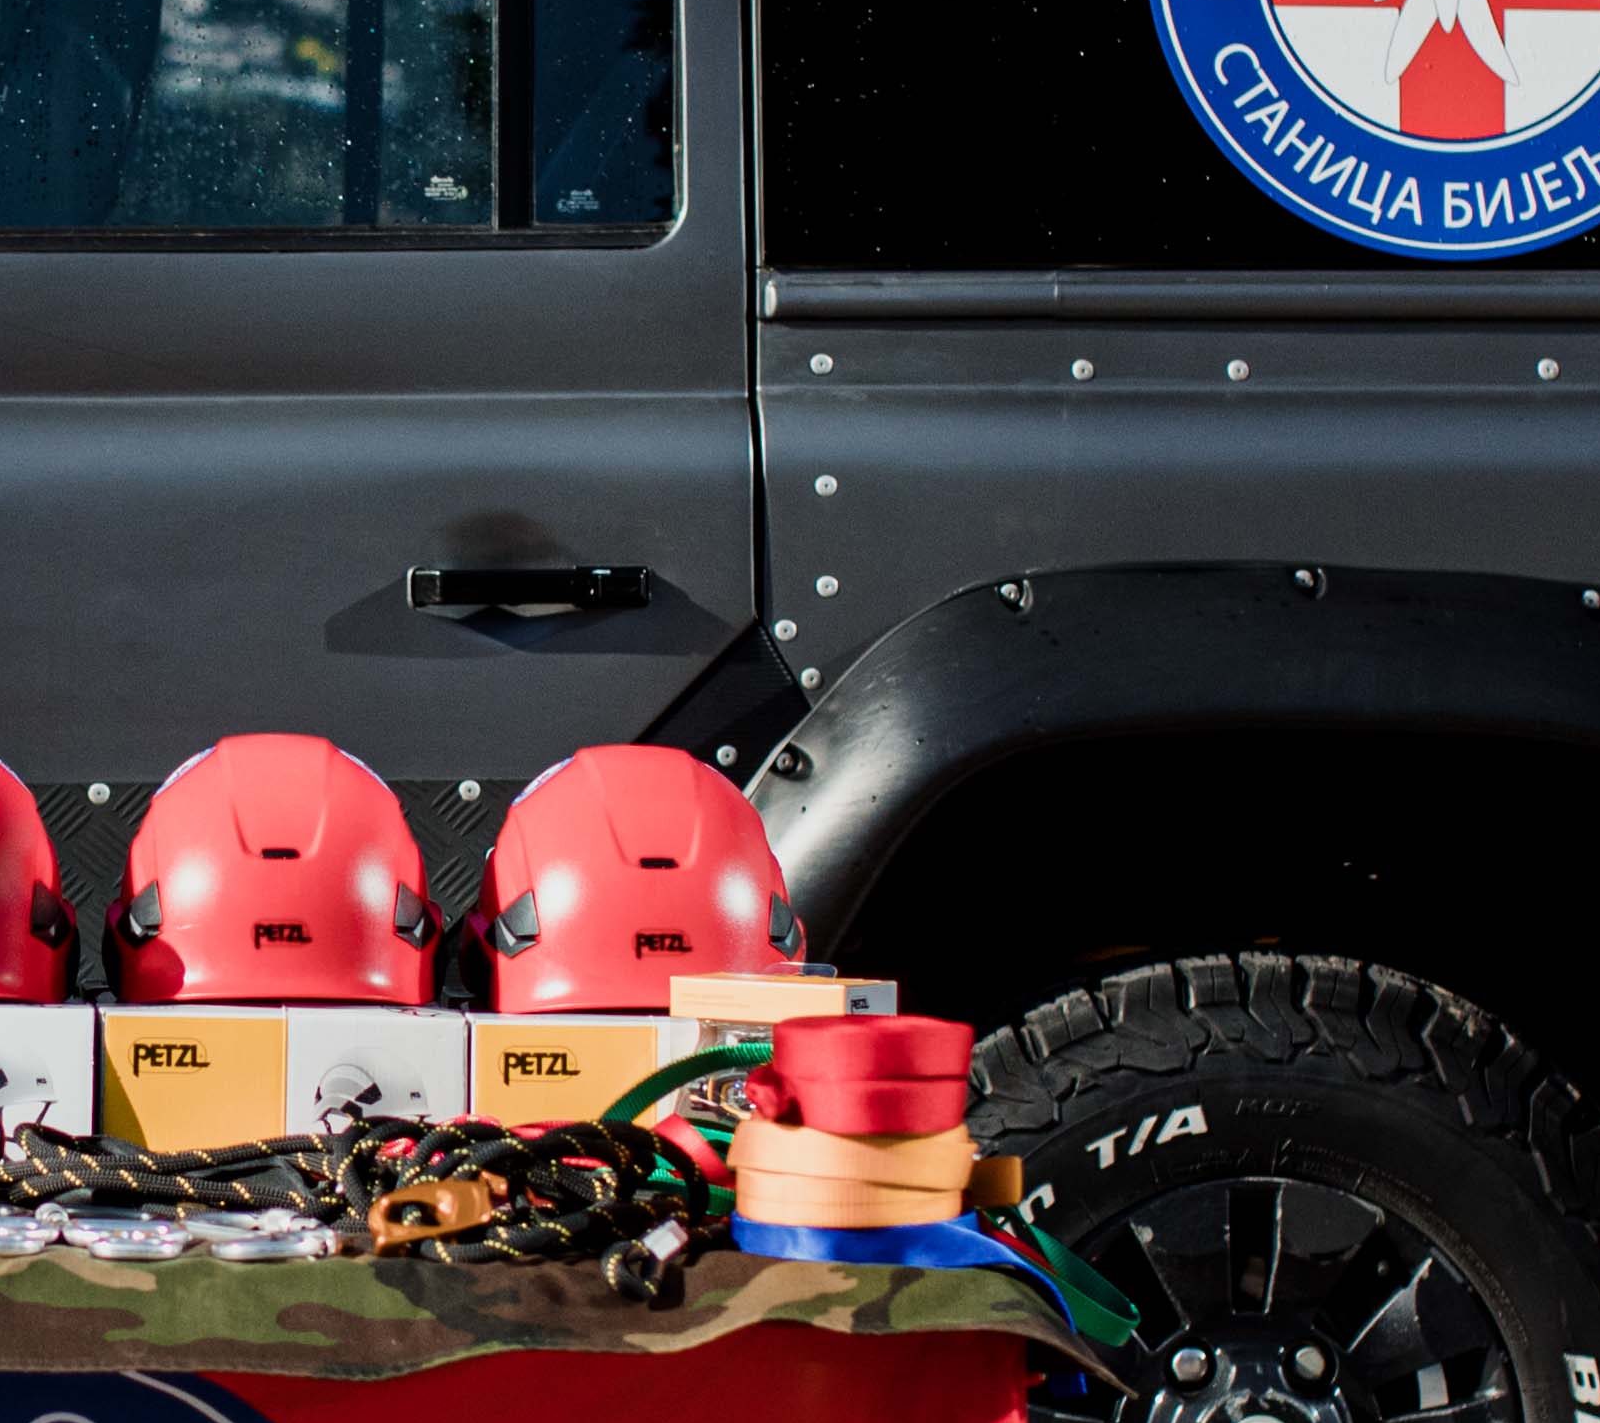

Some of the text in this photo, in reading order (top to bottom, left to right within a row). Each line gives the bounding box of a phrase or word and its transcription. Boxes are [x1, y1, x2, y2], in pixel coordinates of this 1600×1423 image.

[1214, 42, 1424, 225] СТАНИЦА
[254, 922, 313, 950] PETZL
[636, 930, 693, 959] PETZL
[133, 1043, 210, 1077] PETZL
[503, 1051, 581, 1086] PETZL
[1085, 1104, 1209, 1170] T/A
